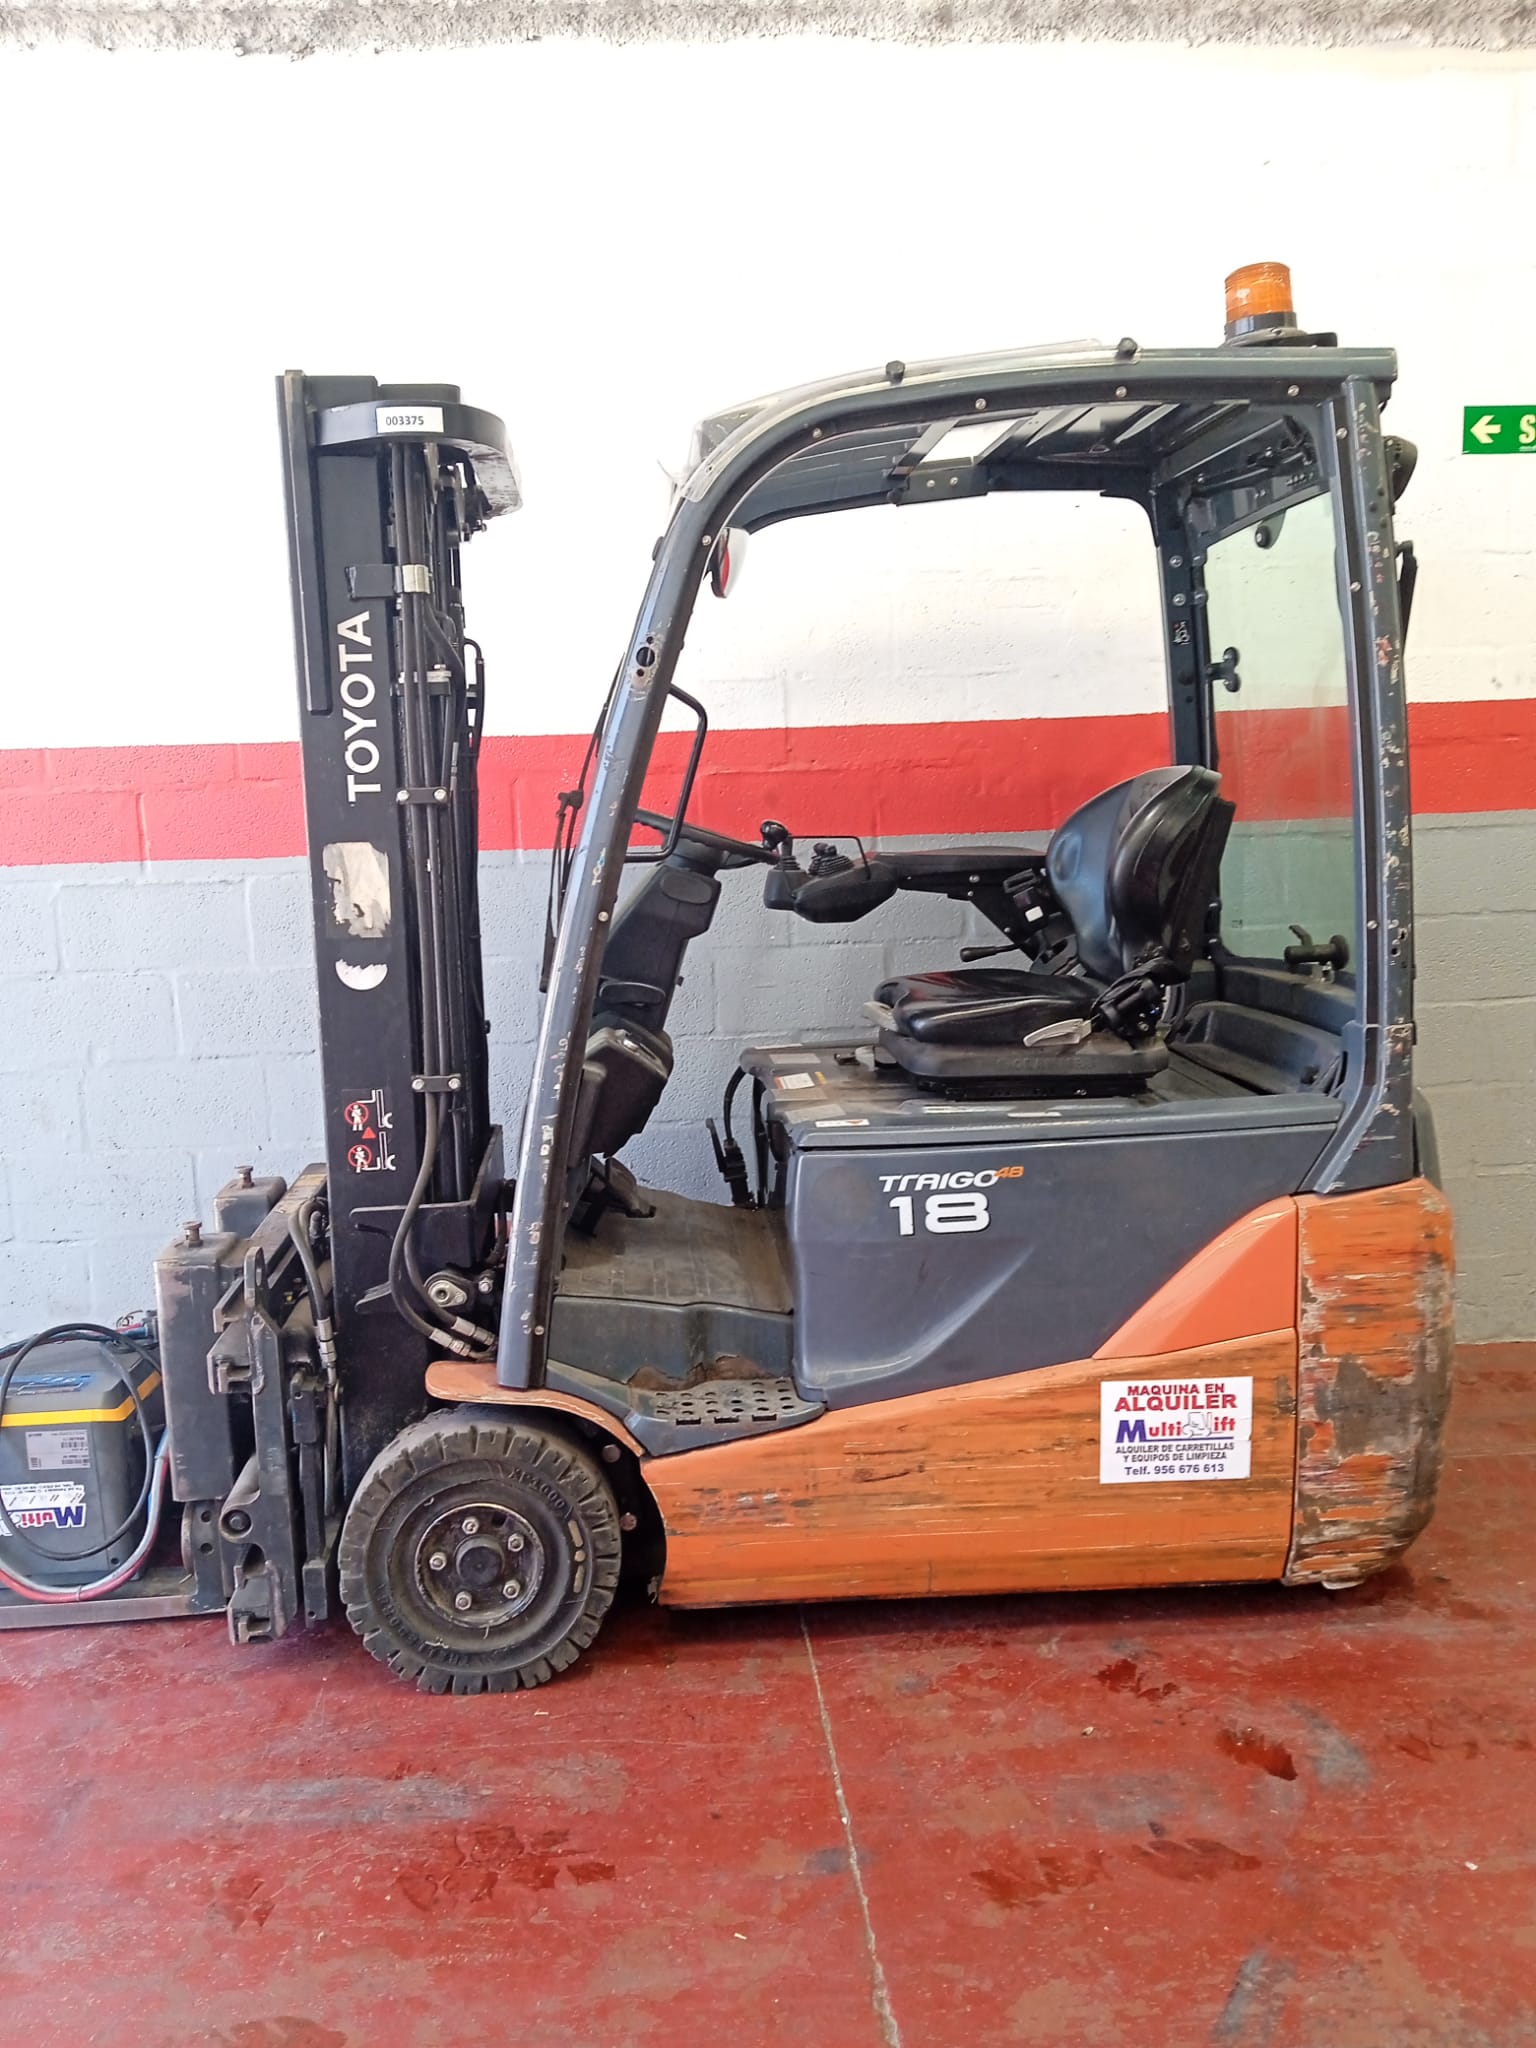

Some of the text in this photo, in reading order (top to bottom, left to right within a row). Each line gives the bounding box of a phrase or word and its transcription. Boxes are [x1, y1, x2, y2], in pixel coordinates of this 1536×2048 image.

[385, 415, 425, 426] 003375
[337, 610, 382, 802] TOYOTA
[878, 1169, 999, 1193] TRAIGO
[889, 1191, 991, 1236] 18
[1127, 1382, 1225, 1396] MAQUINA EN
[1113, 1393, 1238, 1412] ALQUILER
[1115, 1442, 1235, 1454] ALQUILER DE CARRETILLAS
[1131, 1453, 1170, 1463] EQUIPOS
[1172, 1453, 1184, 1462] DE
[1186, 1451, 1227, 1461] LIMPIEZA
[1124, 1463, 1225, 1476] Telf. 956 676 613
